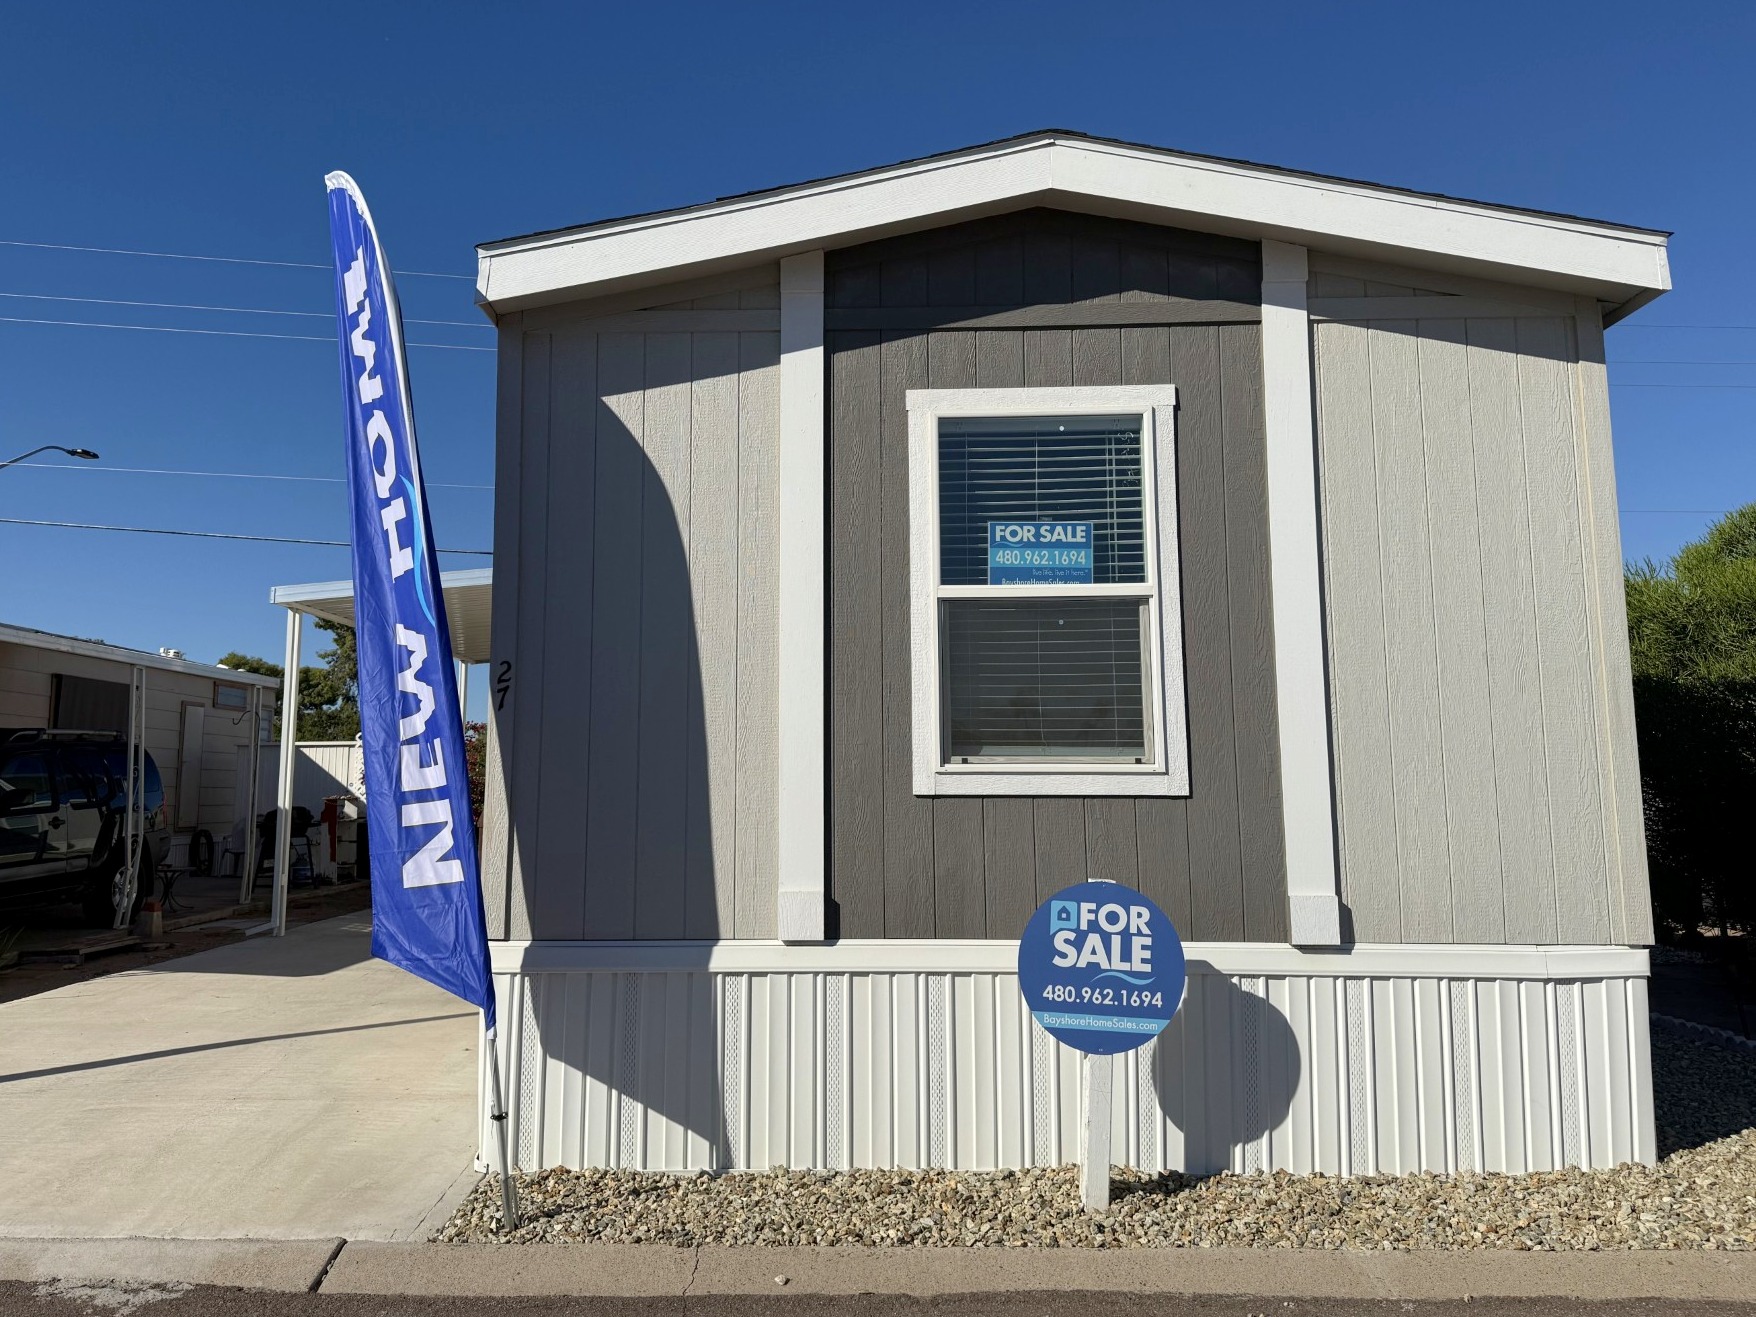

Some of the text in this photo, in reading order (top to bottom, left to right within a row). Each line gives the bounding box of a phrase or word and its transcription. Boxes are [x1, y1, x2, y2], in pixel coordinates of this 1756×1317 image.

[995, 525, 1086, 542] FOR SALE
[343, 244, 465, 888] NEW HOME
[995, 550, 1086, 565] 480.962.1694
[1079, 902, 1152, 935] FOR
[1052, 930, 1152, 972] SALE
[1043, 985, 1163, 1008] 480.962.1694
[1043, 1014, 1158, 1031] BayshoreHomeSales.com
